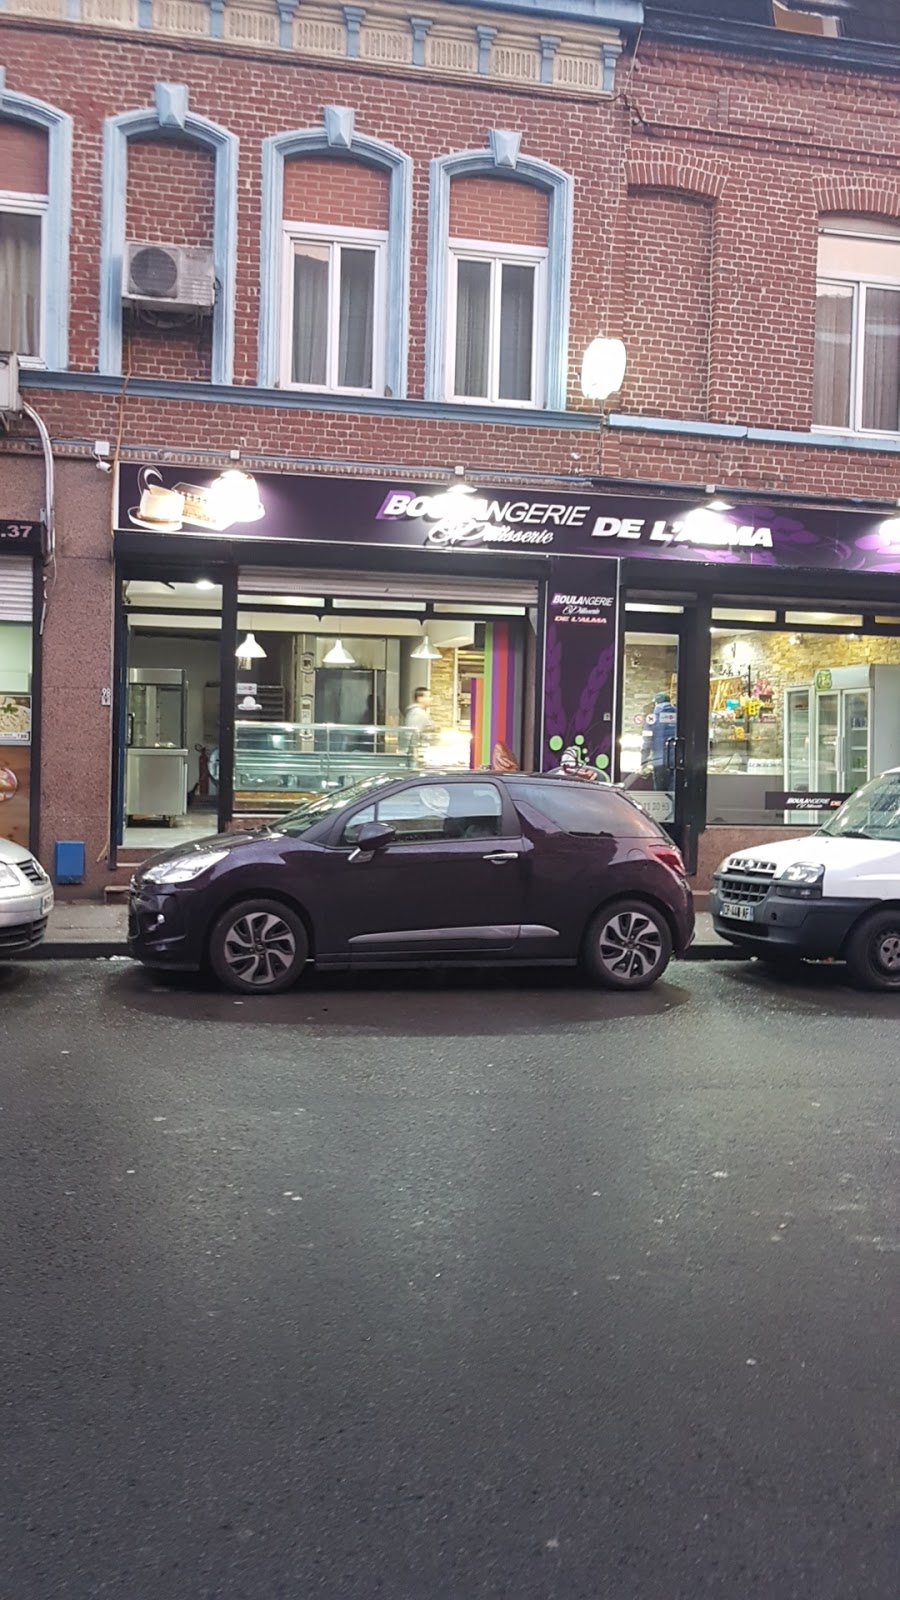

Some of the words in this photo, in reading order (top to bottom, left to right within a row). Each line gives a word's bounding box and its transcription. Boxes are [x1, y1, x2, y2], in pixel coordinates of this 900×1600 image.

[383, 493, 591, 527] BOANGERIE
[591, 517, 646, 540] DE
[649, 520, 774, 548] L'MA
[551, 594, 614, 607] BOULANGERIE
[571, 616, 608, 624] L'ALMA
